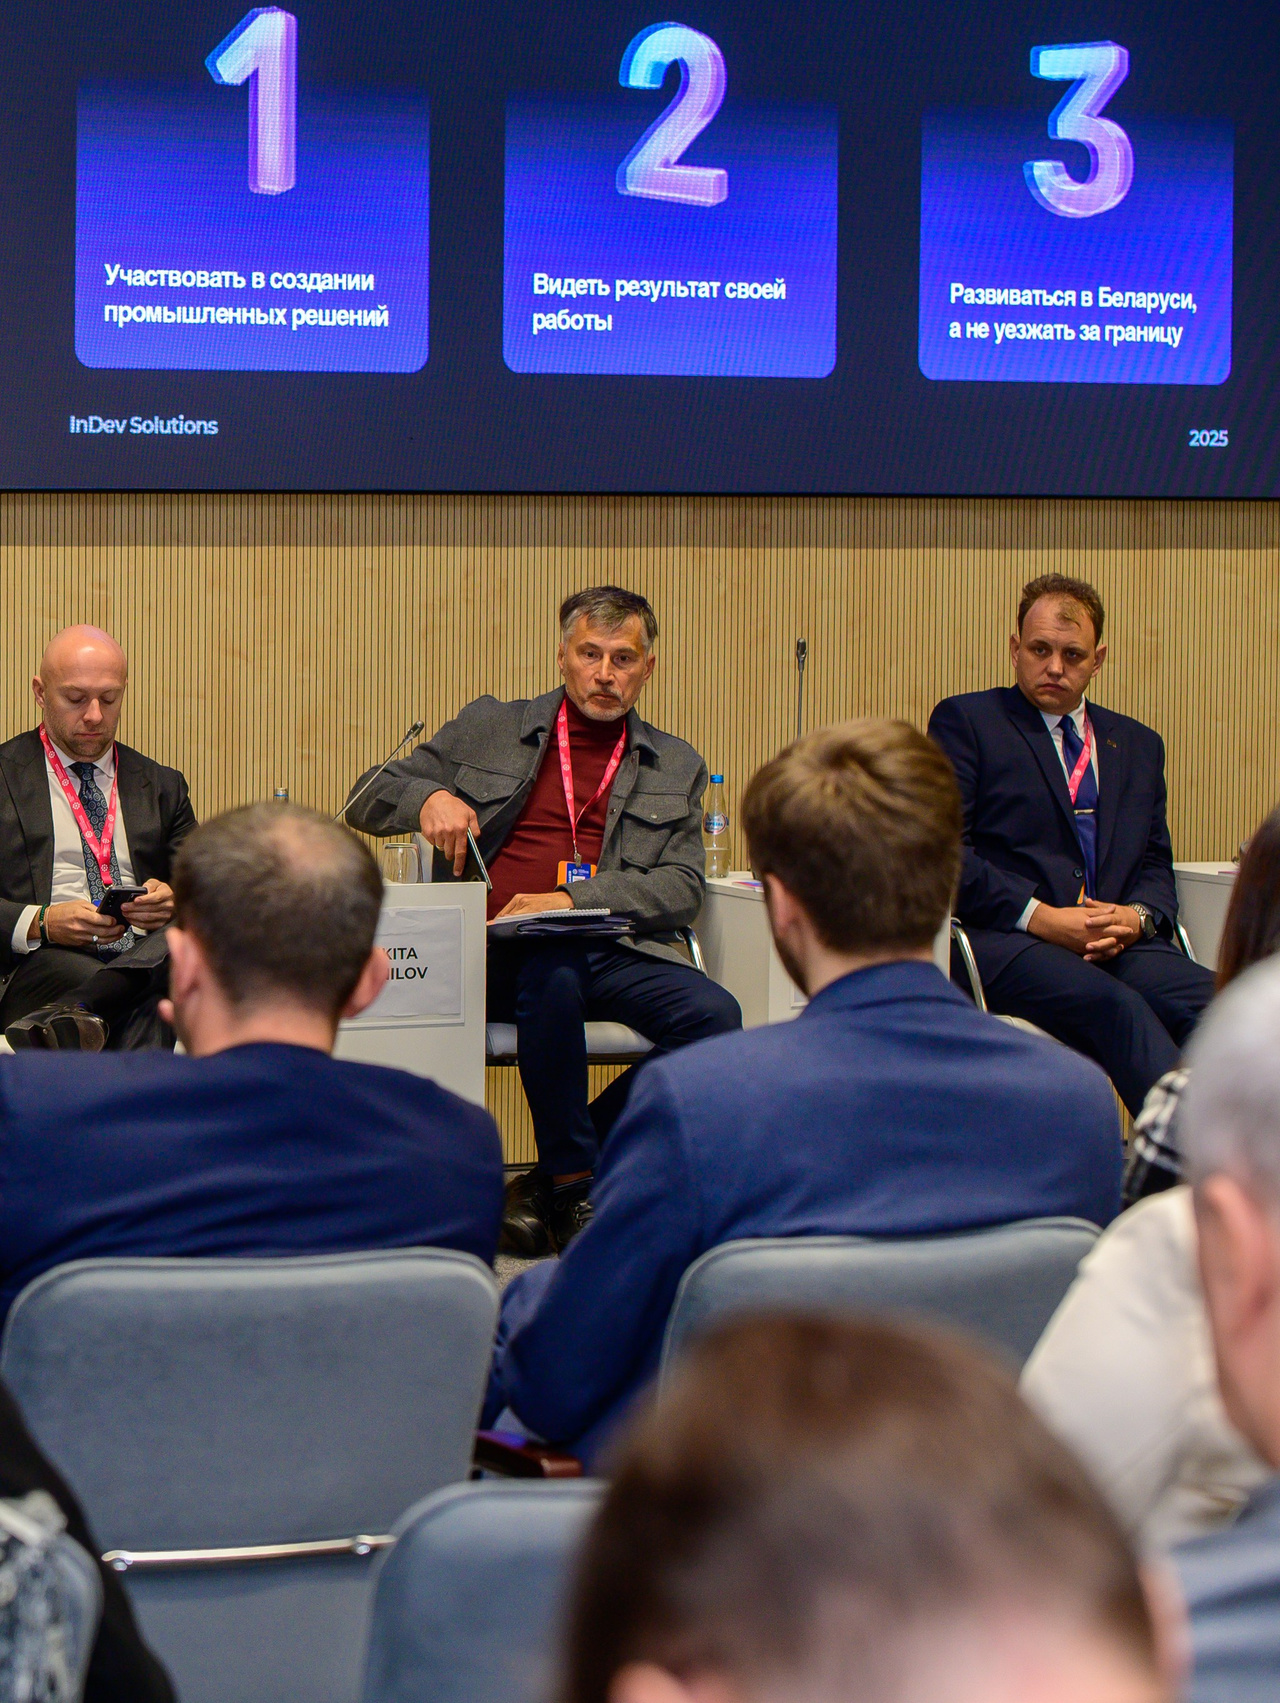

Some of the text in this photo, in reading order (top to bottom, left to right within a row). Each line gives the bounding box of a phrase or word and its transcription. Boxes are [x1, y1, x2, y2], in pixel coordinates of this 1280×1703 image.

[205, 5, 298, 196] 1
[616, 21, 728, 207] 2
[1022, 40, 1134, 219] 3
[104, 264, 374, 293] Участвовать в создании
[533, 273, 786, 302] Видеть результат своей
[950, 283, 1197, 314] Развиваться в Беларуси,
[104, 304, 389, 331] промышленных решений
[533, 309, 613, 335] работы
[949, 322, 1183, 348] а не уезжать за границу
[70, 414, 219, 435] InDev Solutions
[1188, 429, 1229, 447] 2025
[384, 947, 418, 960] KITA
[387, 966, 429, 980] ILOV
